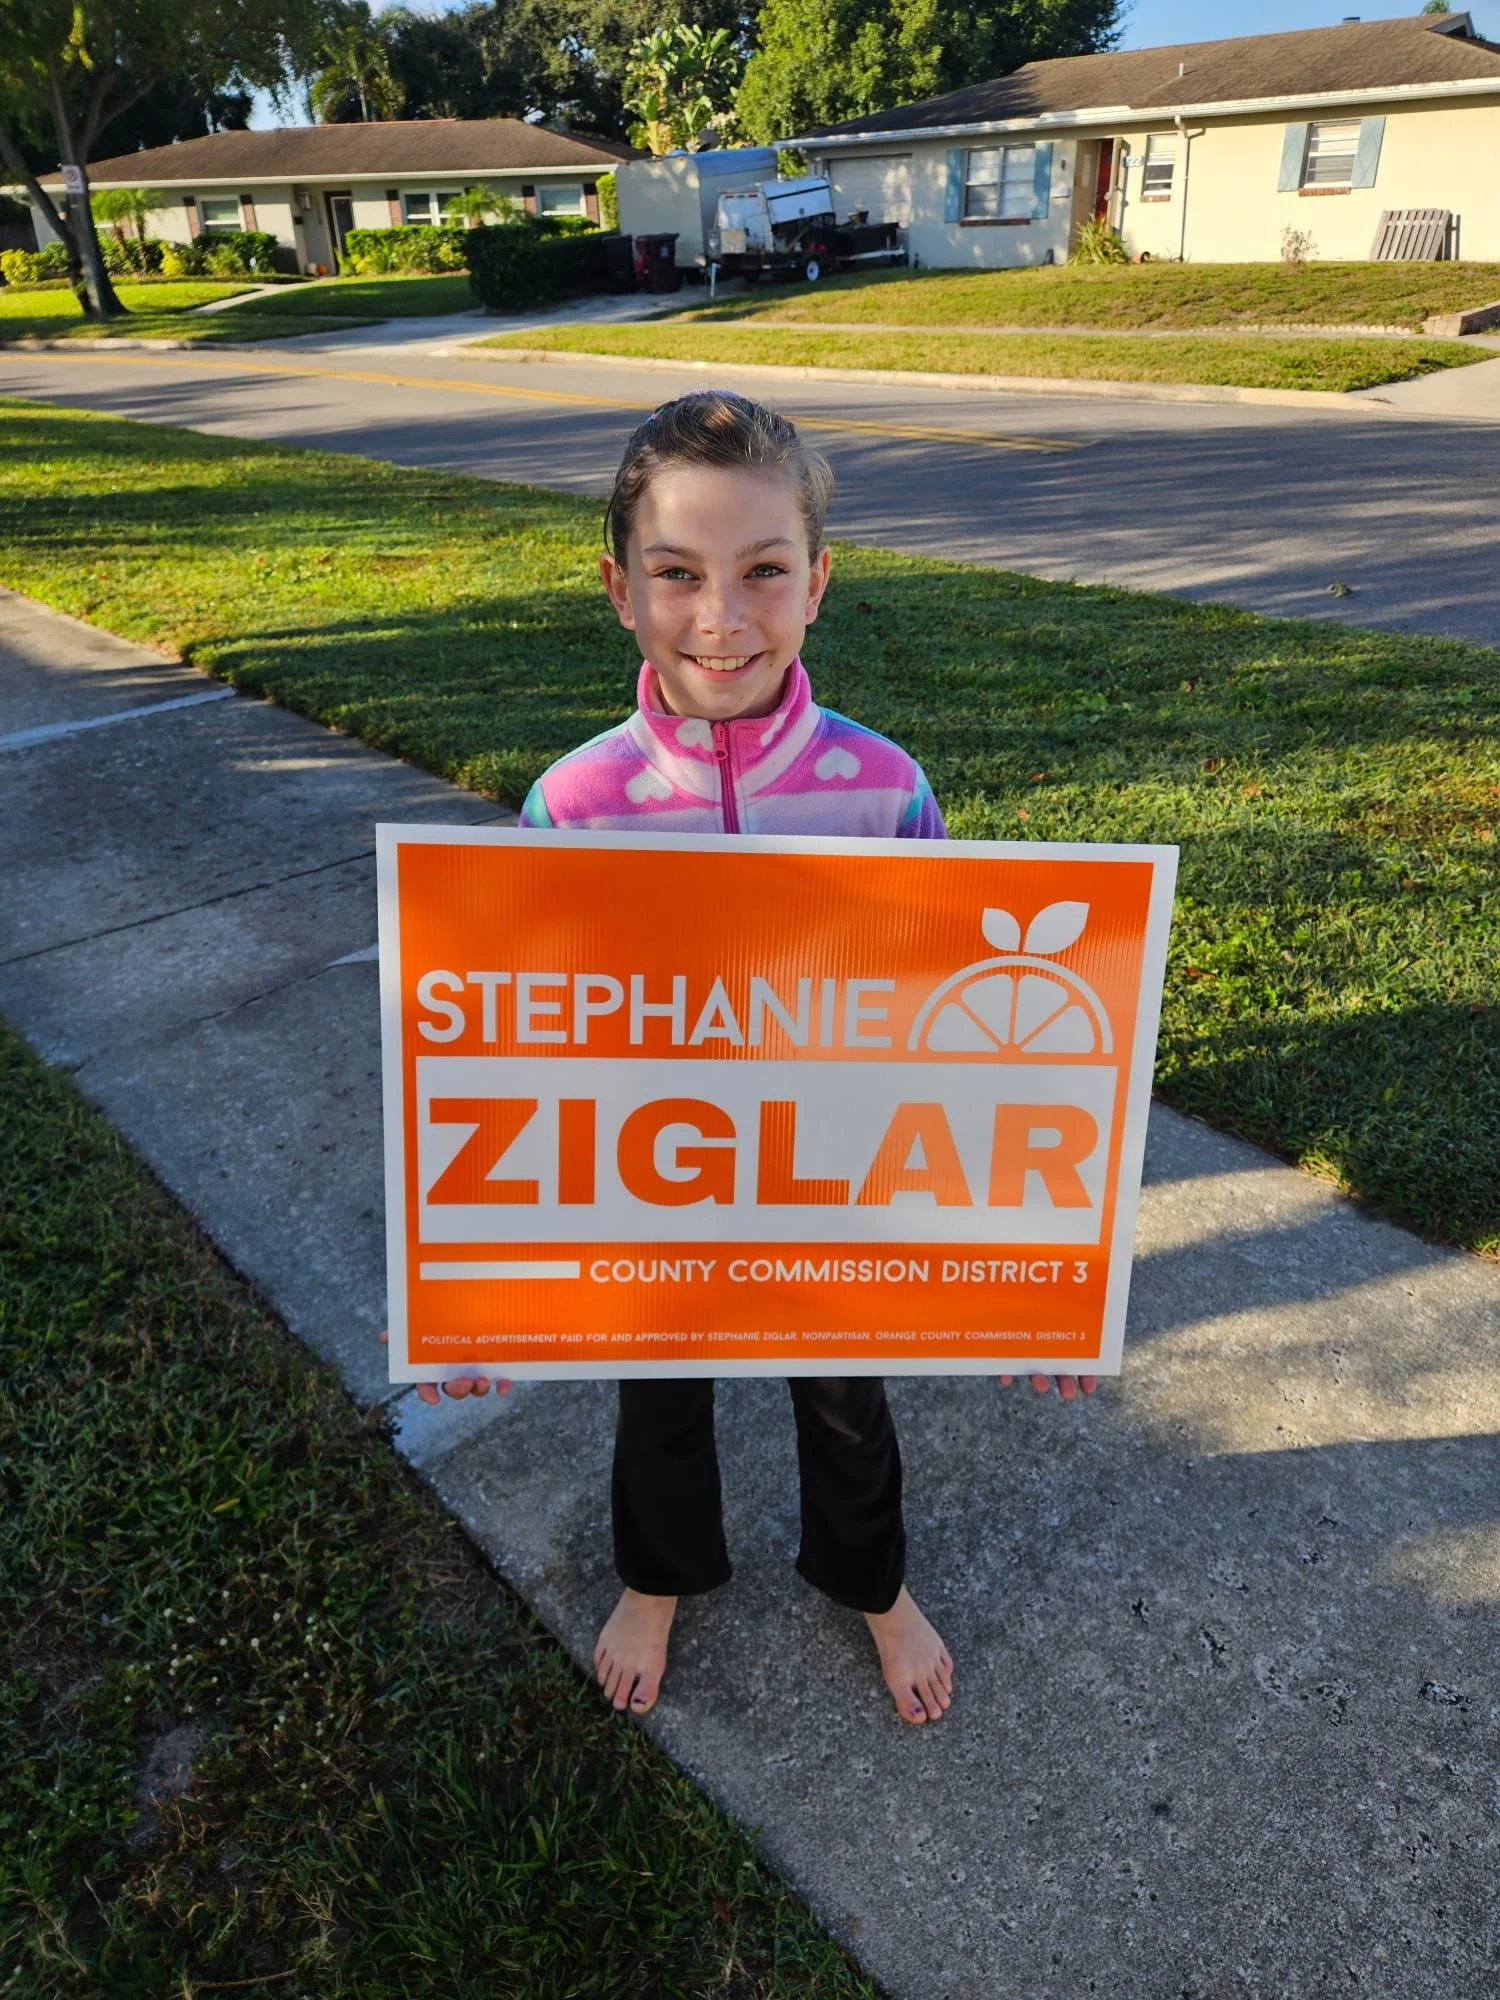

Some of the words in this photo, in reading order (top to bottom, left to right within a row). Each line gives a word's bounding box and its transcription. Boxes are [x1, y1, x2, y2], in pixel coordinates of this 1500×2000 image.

[417, 970, 896, 1048] STEPHANIE
[426, 1097, 1099, 1208] ZIGLAR
[589, 1259, 717, 1284] COUNTY
[728, 1259, 930, 1284] COMMISSION
[941, 1260, 1064, 1284] DISTRICT
[1072, 1261, 1089, 1284] 3
[421, 1335, 472, 1345] POLITICAL
[476, 1334, 558, 1344] ADVERTISEMENT
[561, 1333, 582, 1343] PAID
[586, 1333, 608, 1343] FOR
[611, 1333, 632, 1342] AND
[635, 1332, 688, 1342] APPROVED
[691, 1332, 704, 1341] BY
[707, 1331, 760, 1342] STEPHANIE
[875, 1331, 917, 1341] ORANGE
[920, 1331, 961, 1341] COUNTY
[1036, 1331, 1076, 1341] DISTRICT
[1079, 1332, 1086, 1341] 3
